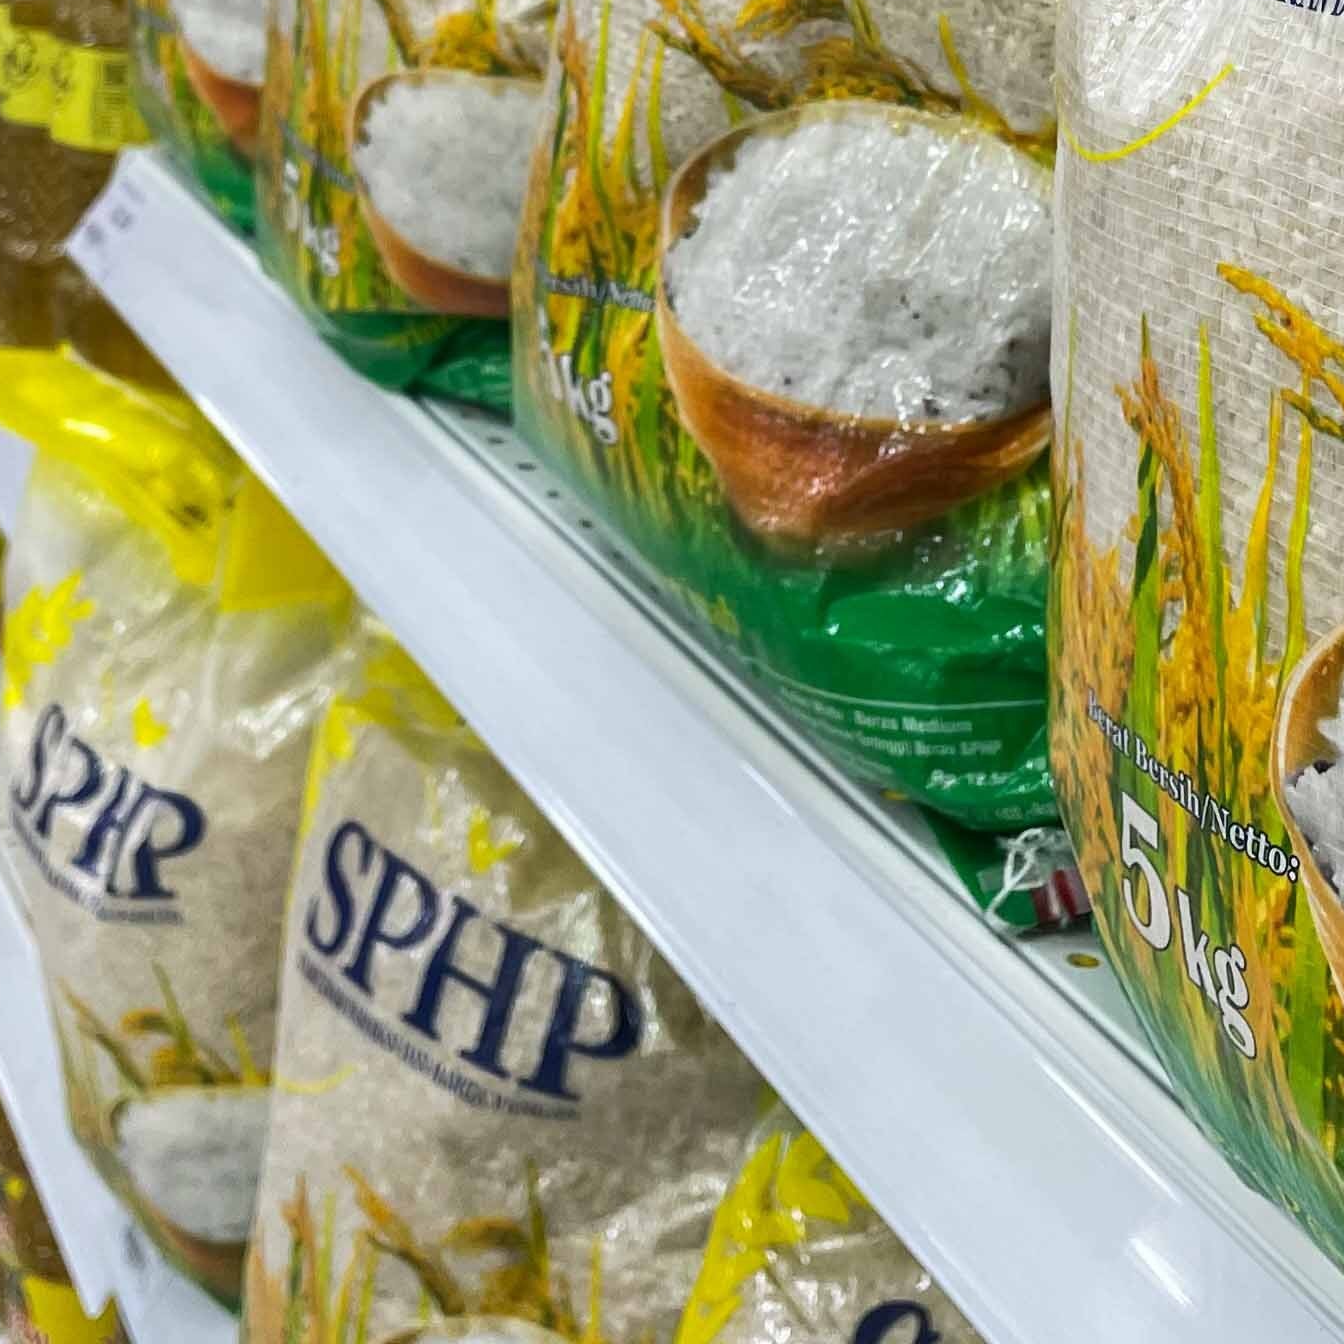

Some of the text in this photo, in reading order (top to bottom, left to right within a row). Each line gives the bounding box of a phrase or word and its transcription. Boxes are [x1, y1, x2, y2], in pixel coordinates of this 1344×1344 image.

[560, 353, 619, 445] kg
[1087, 686, 1302, 884] Berat Bersih/Netto:
[305, 818, 645, 1104] SPHP
[1120, 790, 1257, 1060] 5 kg
